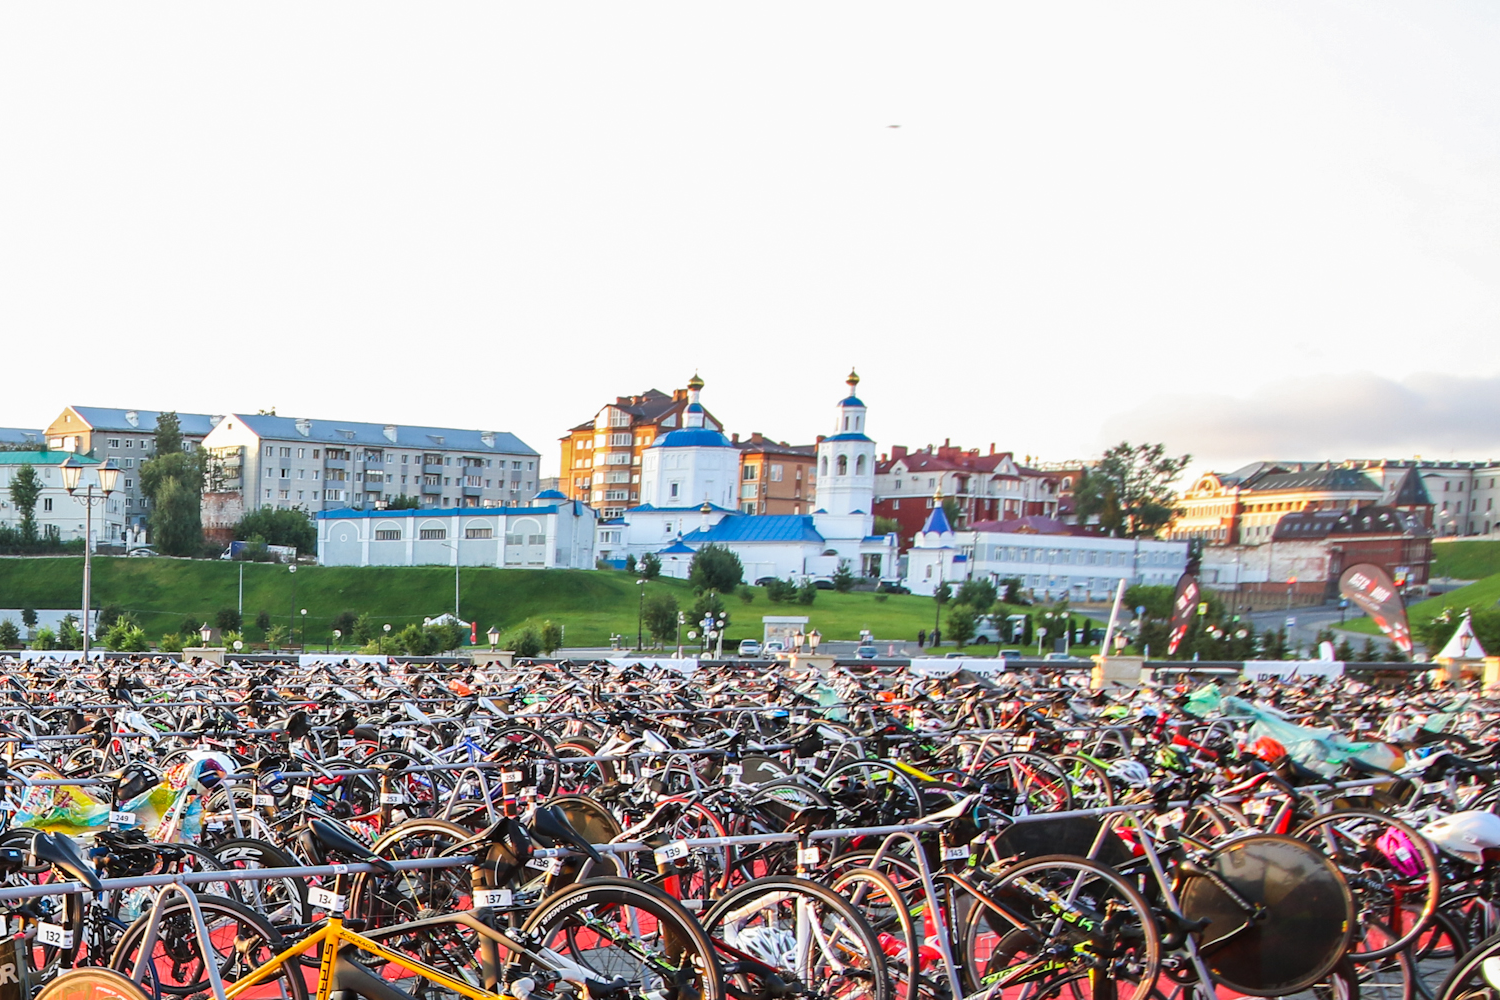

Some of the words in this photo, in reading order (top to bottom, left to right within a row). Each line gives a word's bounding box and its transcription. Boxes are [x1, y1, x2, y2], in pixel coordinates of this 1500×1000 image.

[115, 813, 129, 822] 249
[664, 847, 681, 859] 139
[949, 849, 964, 858] 143
[485, 894, 502, 904] 137
[542, 893, 590, 927] BONTRAGER
[45, 930, 61, 943] 132
